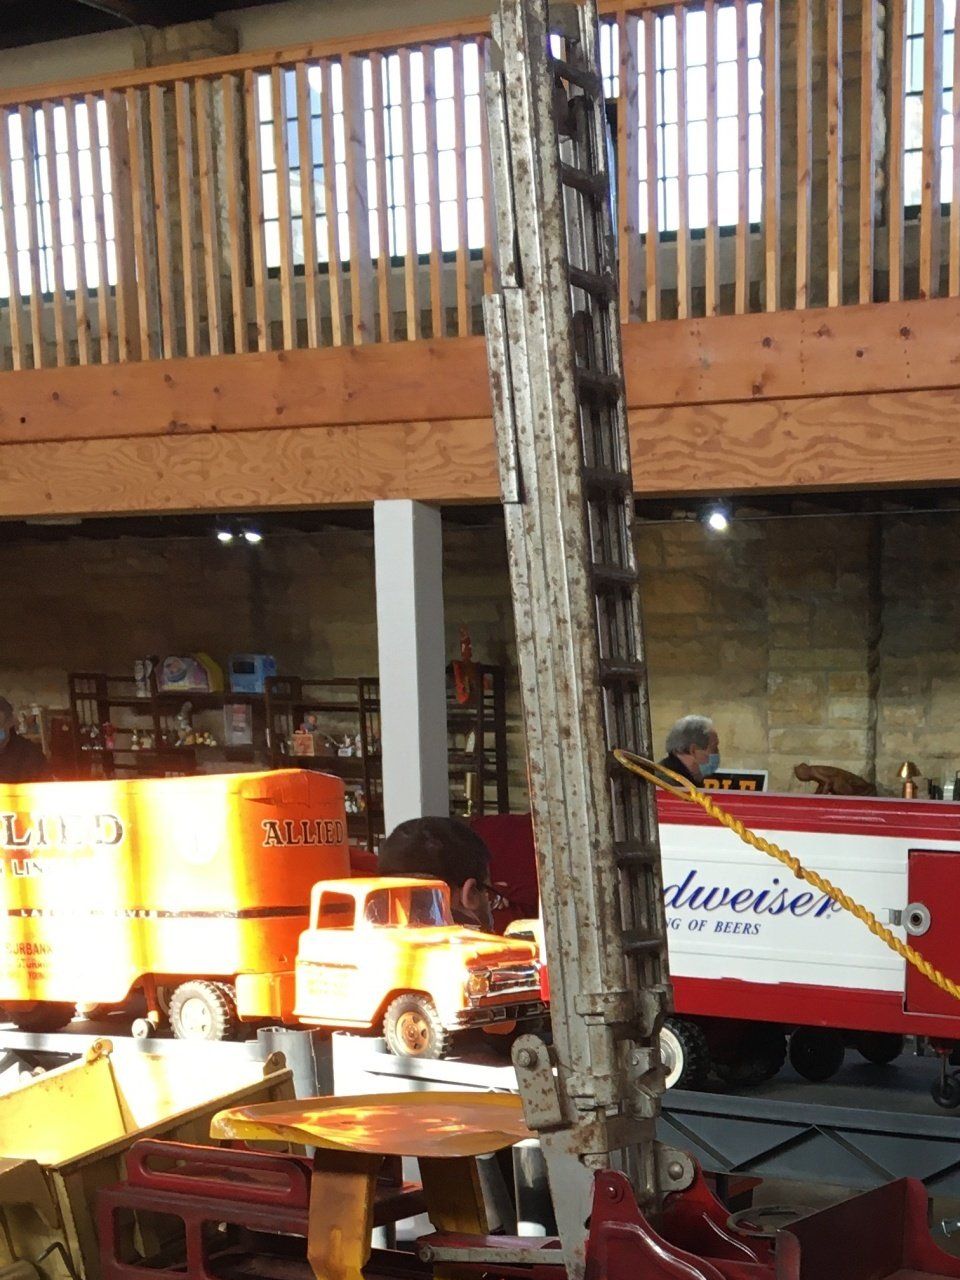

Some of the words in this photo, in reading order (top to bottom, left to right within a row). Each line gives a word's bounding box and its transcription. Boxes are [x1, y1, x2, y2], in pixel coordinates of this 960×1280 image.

[263, 819, 344, 847] ALLIED
[688, 918, 708, 931] OF
[714, 921, 762, 936] BEERS
